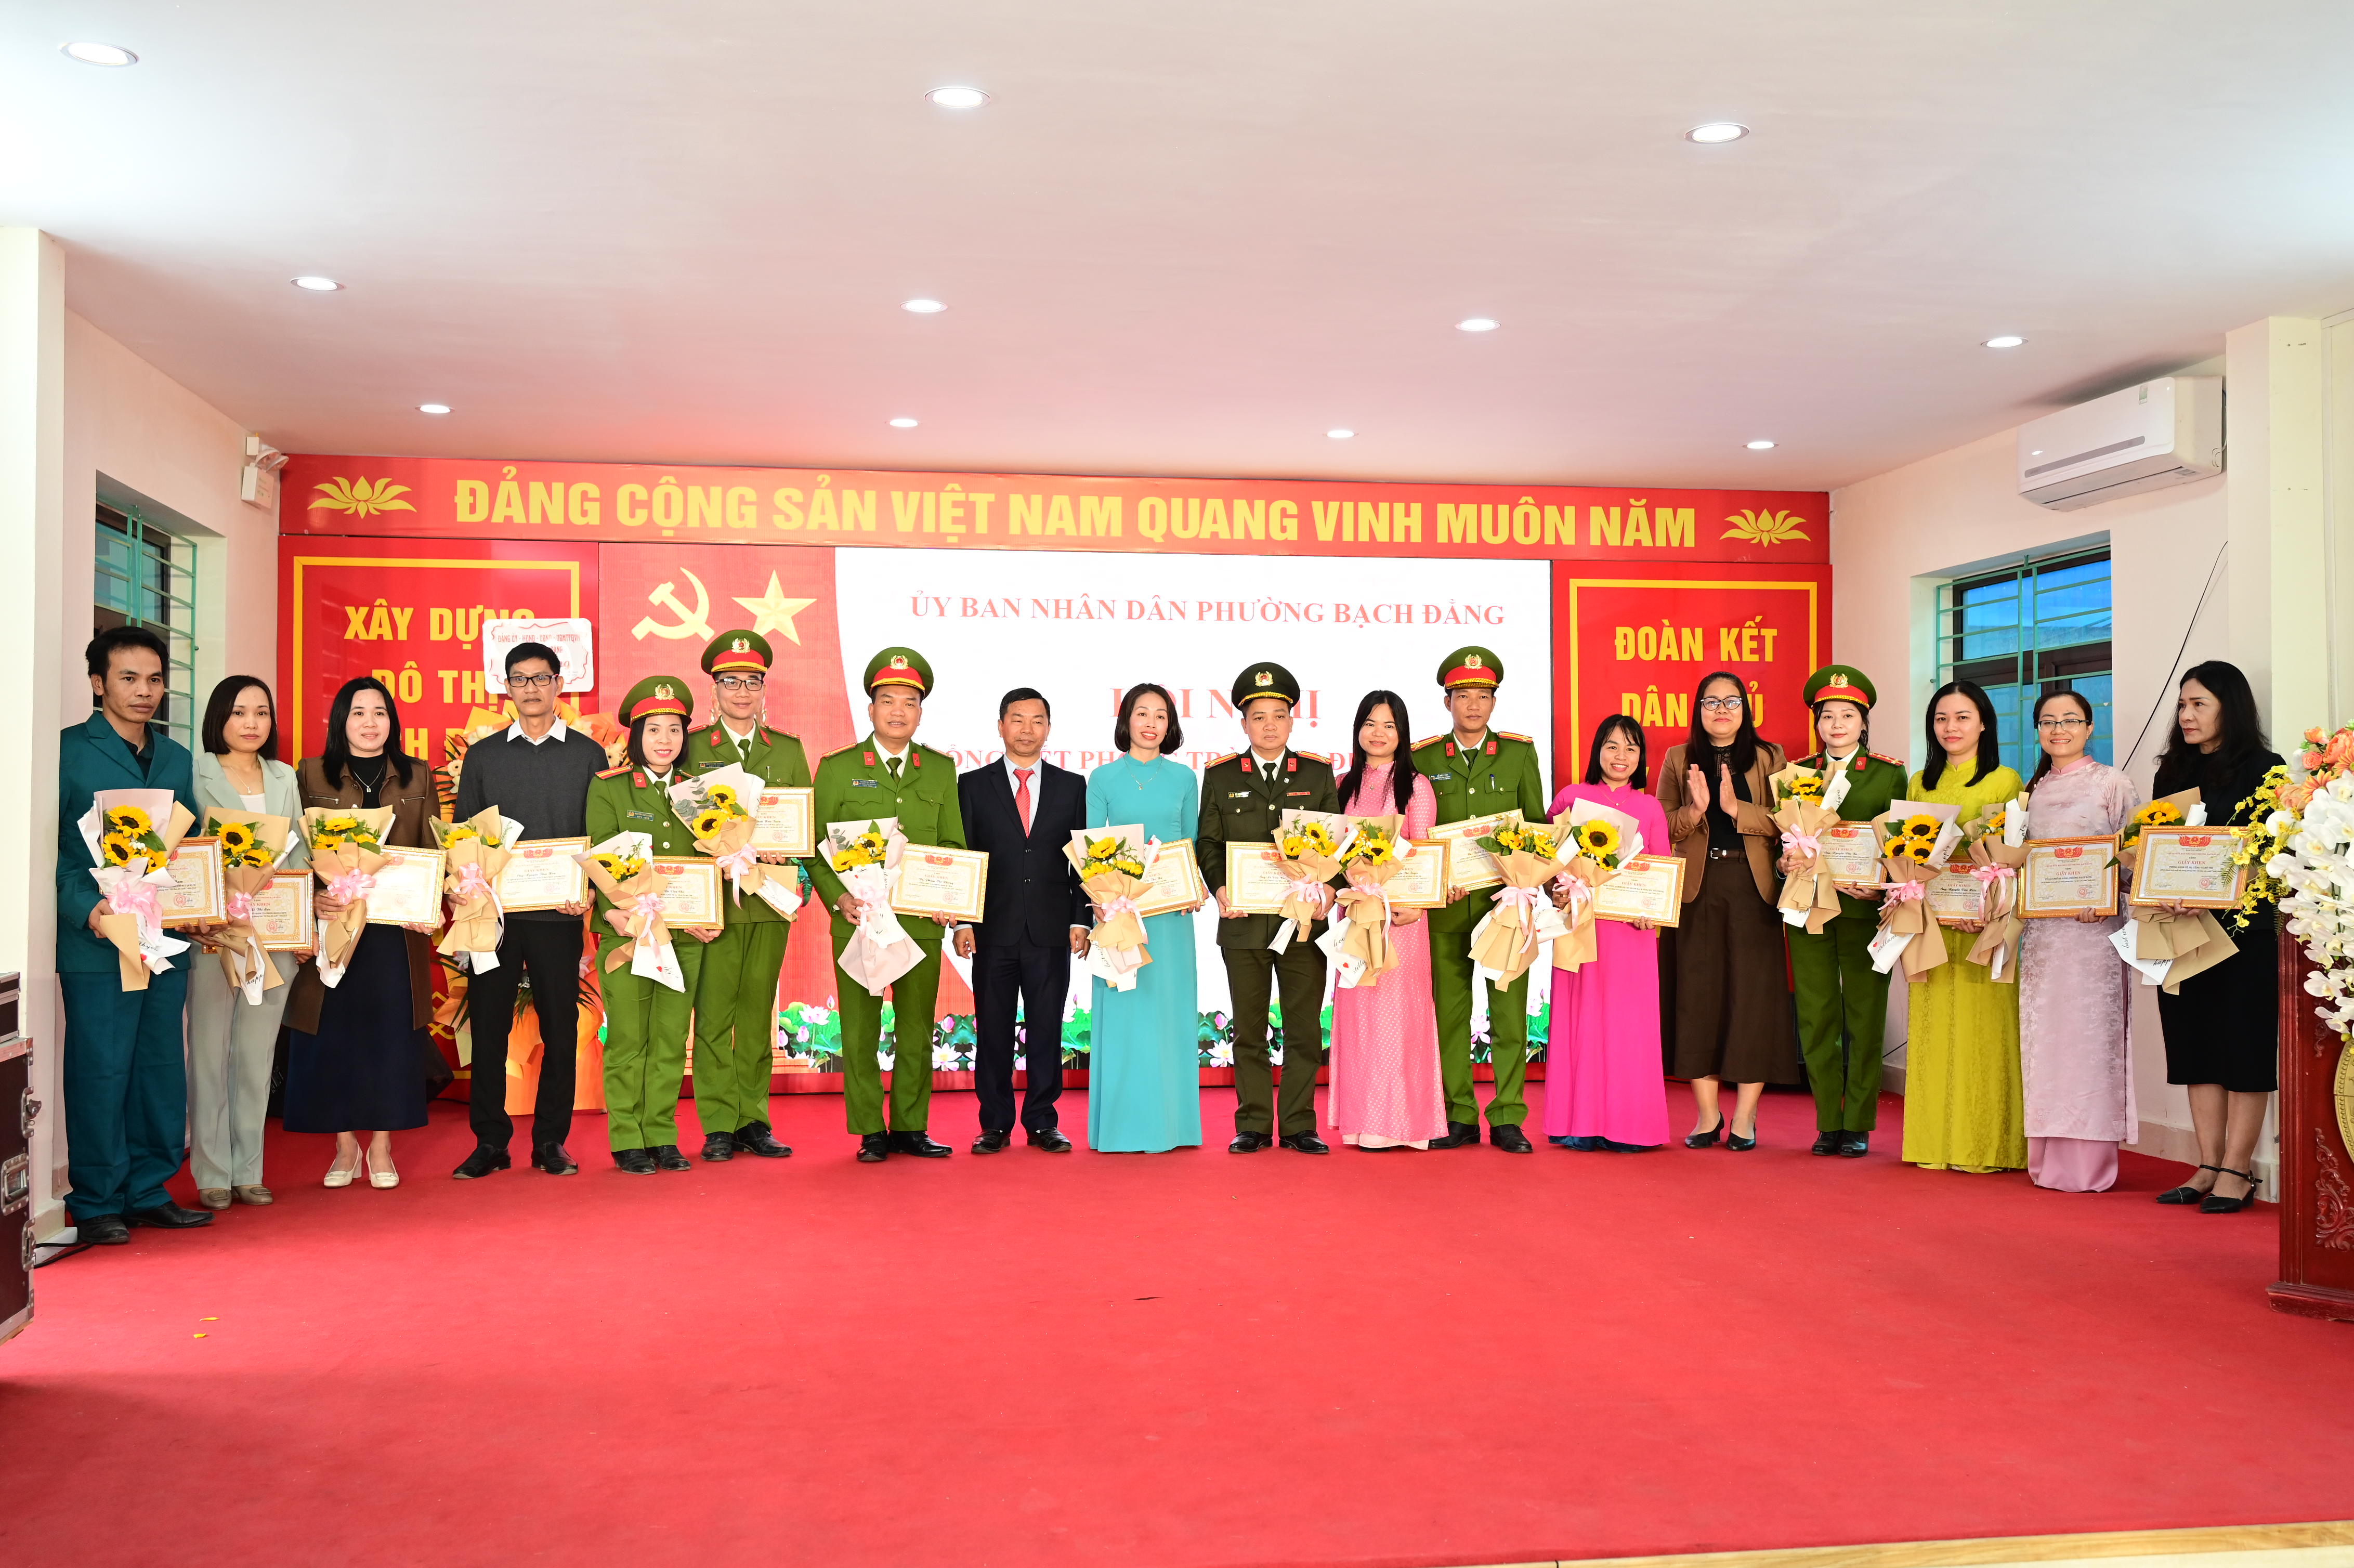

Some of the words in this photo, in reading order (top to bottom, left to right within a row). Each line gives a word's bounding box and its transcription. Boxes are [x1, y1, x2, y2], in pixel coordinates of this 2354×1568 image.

[454, 466, 600, 525] ĐẢNG
[617, 476, 757, 537] CỘNG
[773, 475, 876, 531] SẢN
[891, 484, 995, 543] VIỆT
[1009, 494, 1122, 537] NAM
[1137, 497, 1298, 543] QUANG
[1312, 501, 1422, 542] VINH
[1437, 497, 1576, 545] MUÔN
[1590, 499, 1695, 547] NĂM
[344, 598, 414, 641] XÂY
[910, 590, 951, 617] ỦY
[960, 597, 1022, 618] BAN
[1030, 593, 1115, 620] NHÂN
[1125, 594, 1187, 620] DÂN
[1196, 597, 1325, 623] PHƯỜNG
[1332, 604, 1414, 628] BẠCH
[1422, 599, 1505, 625] ĐẰNG
[1615, 619, 1703, 661] ĐOÀN
[1720, 616, 1777, 662] KẾT
[1621, 685, 1688, 727] DÂN
